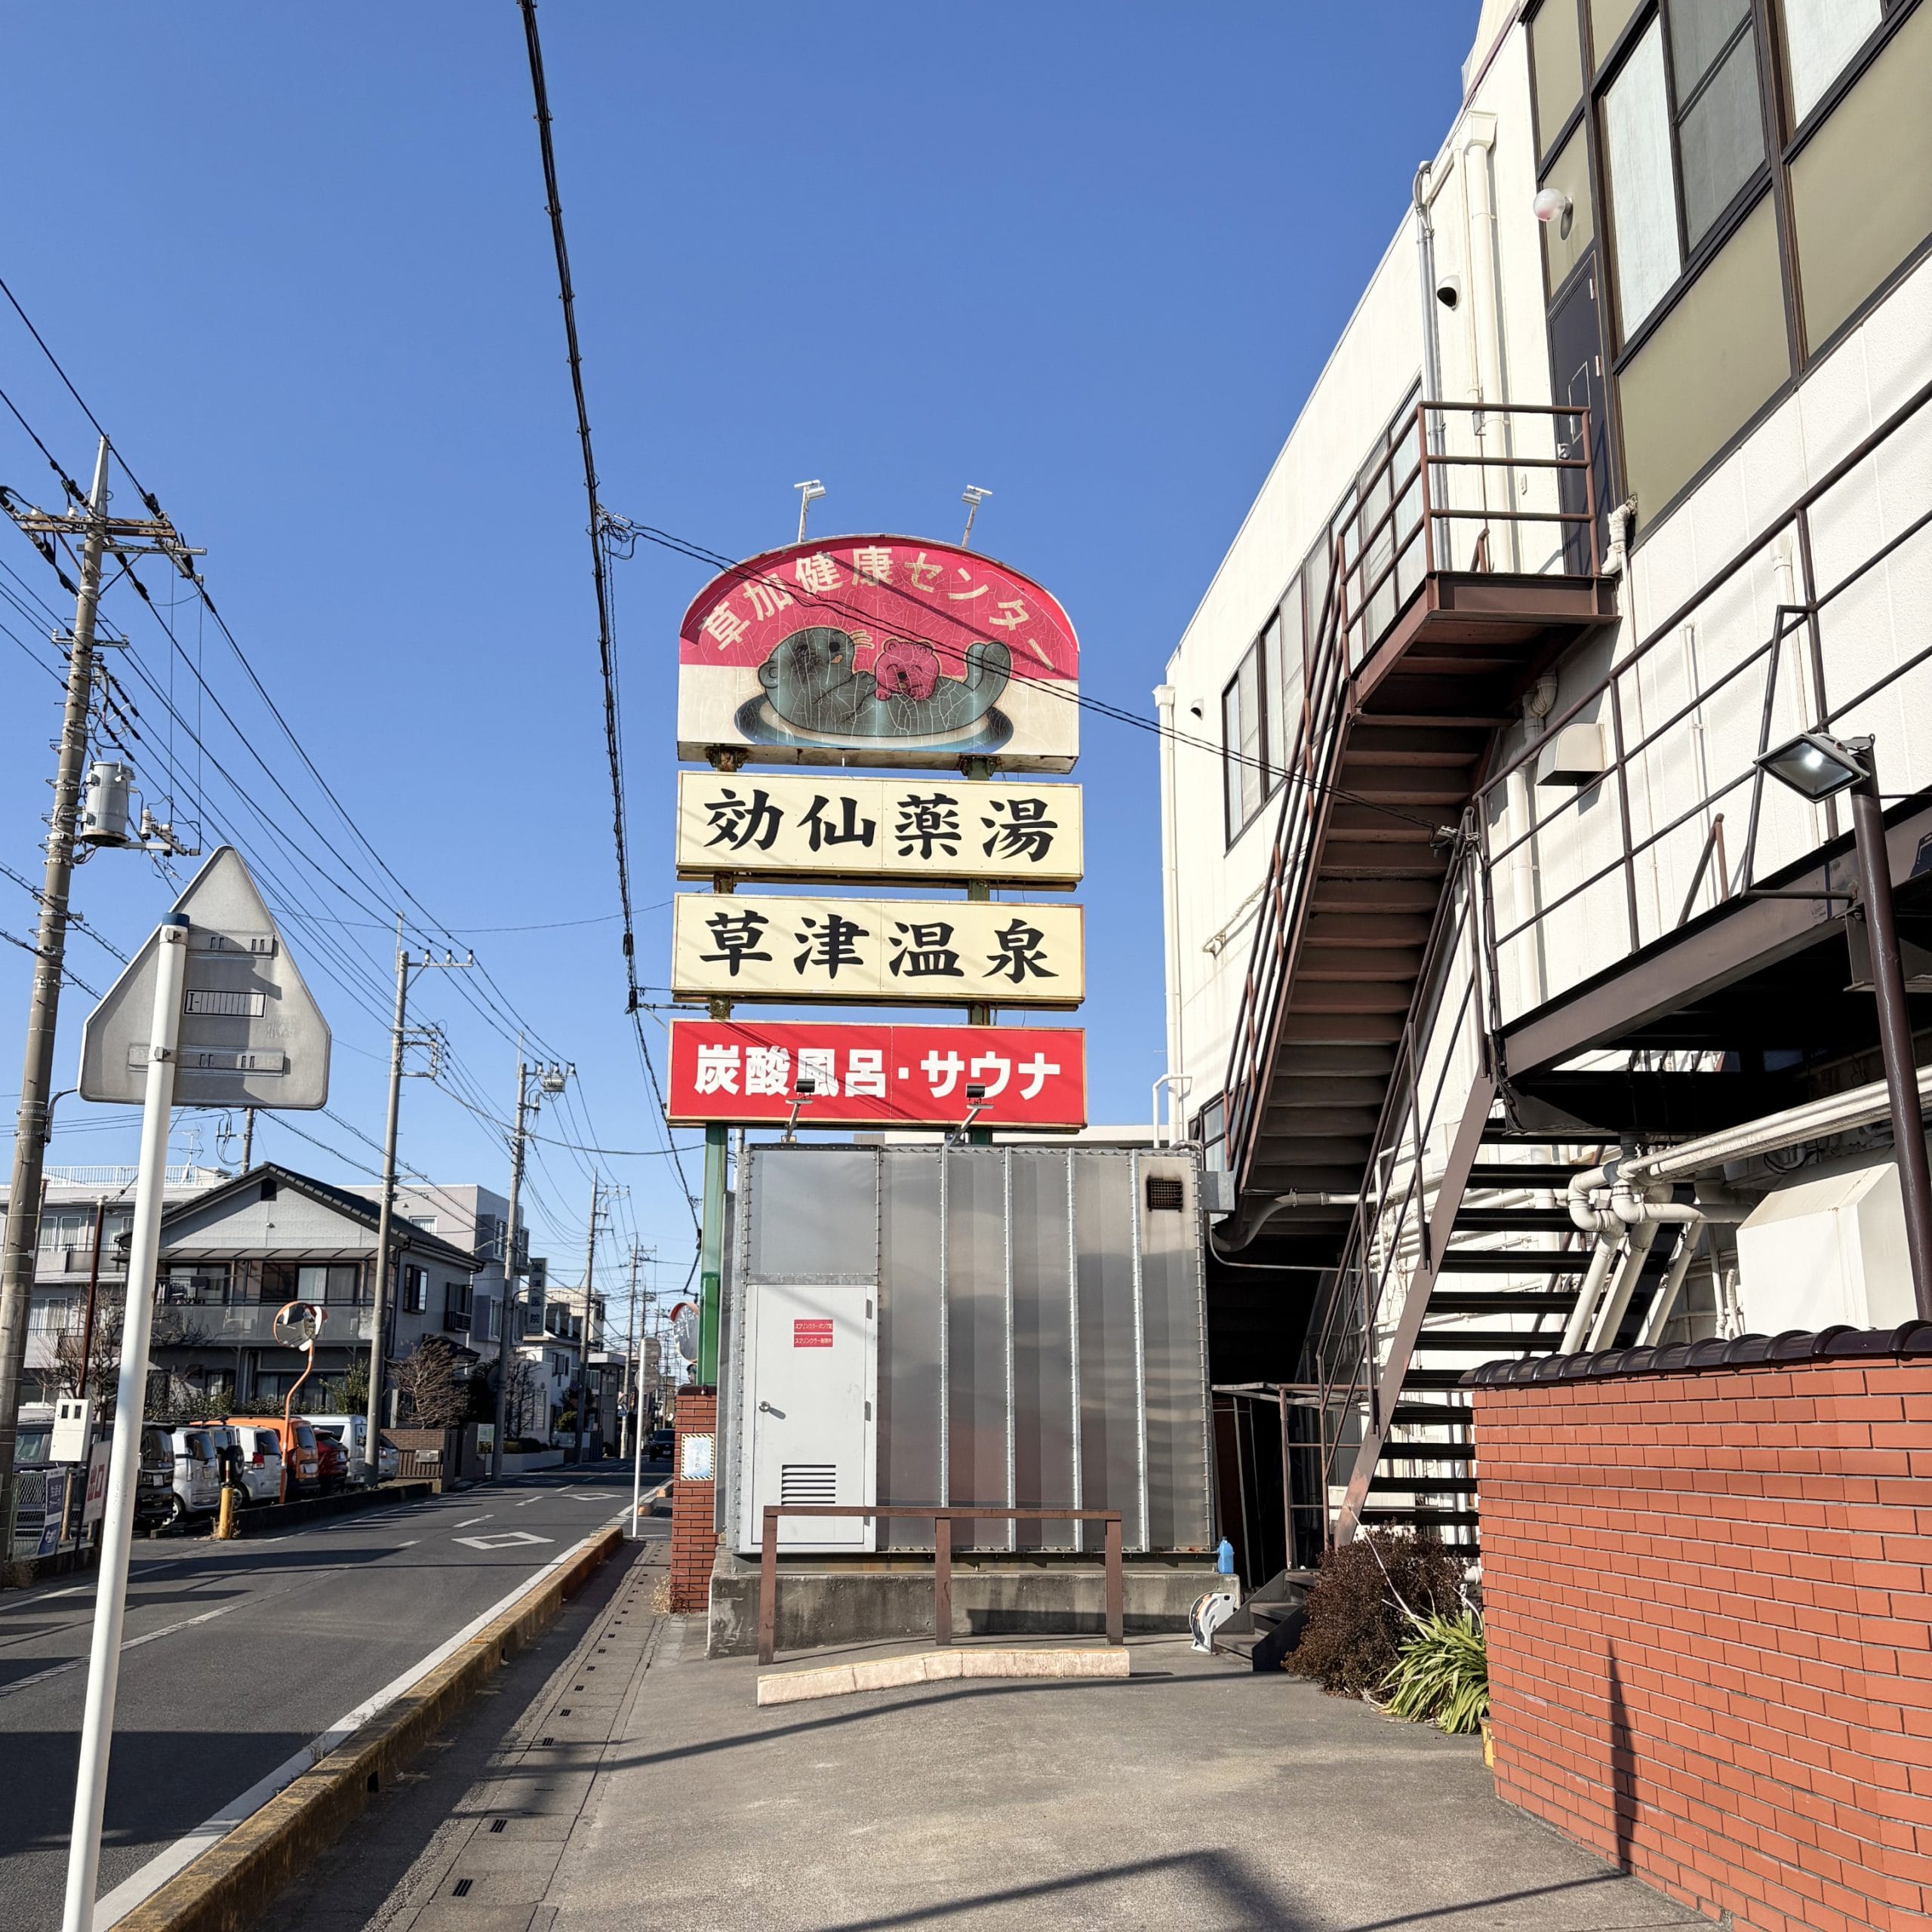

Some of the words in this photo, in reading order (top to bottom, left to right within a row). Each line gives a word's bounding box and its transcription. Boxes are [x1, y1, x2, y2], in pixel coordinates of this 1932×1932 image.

[699, 545, 1054, 670] 草加健康センター
[703, 788, 1058, 863] 効仙薬湯
[699, 909, 1059, 985] 草津温泉
[694, 1044, 1060, 1100] 炭酸風呂・サウナ
[88, 1464, 104, 1501] 出口
